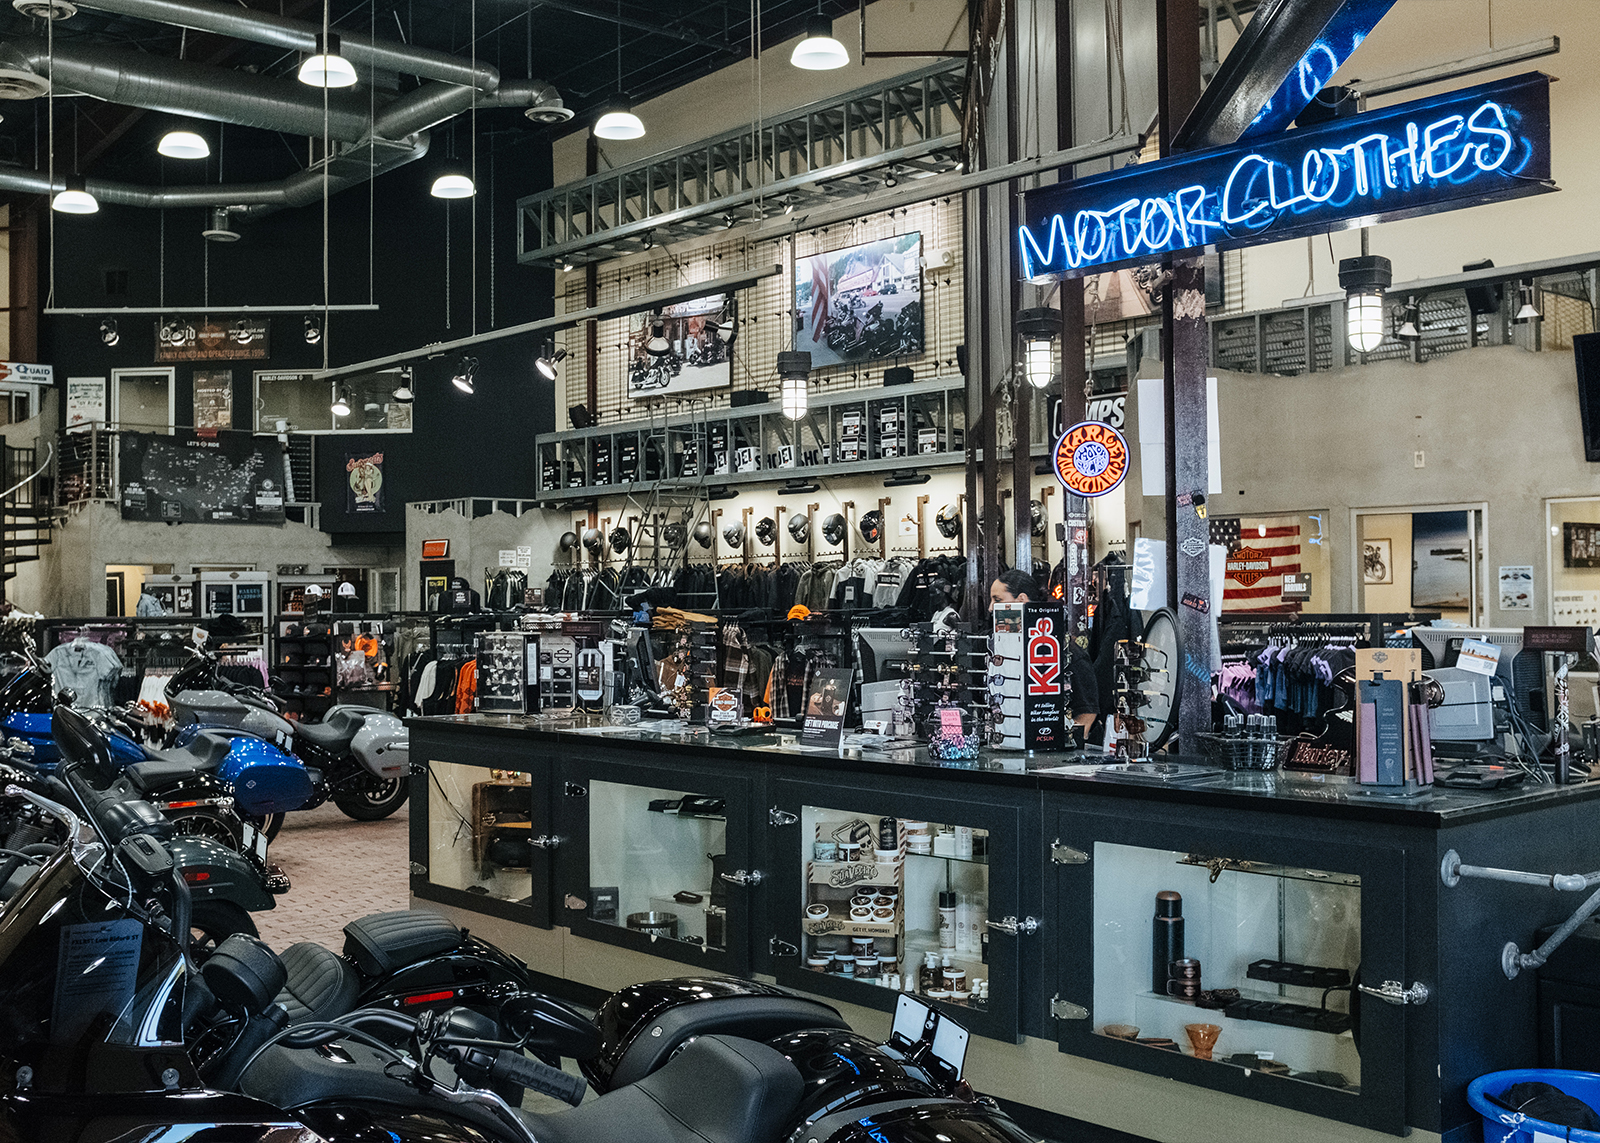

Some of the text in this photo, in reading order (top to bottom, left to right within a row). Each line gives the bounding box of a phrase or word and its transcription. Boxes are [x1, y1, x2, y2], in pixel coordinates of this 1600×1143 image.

[235, 349, 250, 357] SINCE
[15, 364, 50, 375] QUAID
[1226, 561, 1269, 570] HARLEY-DAVIDSON
[1237, 573, 1259, 584] CYCLES
[1028, 617, 1061, 696] KD's
